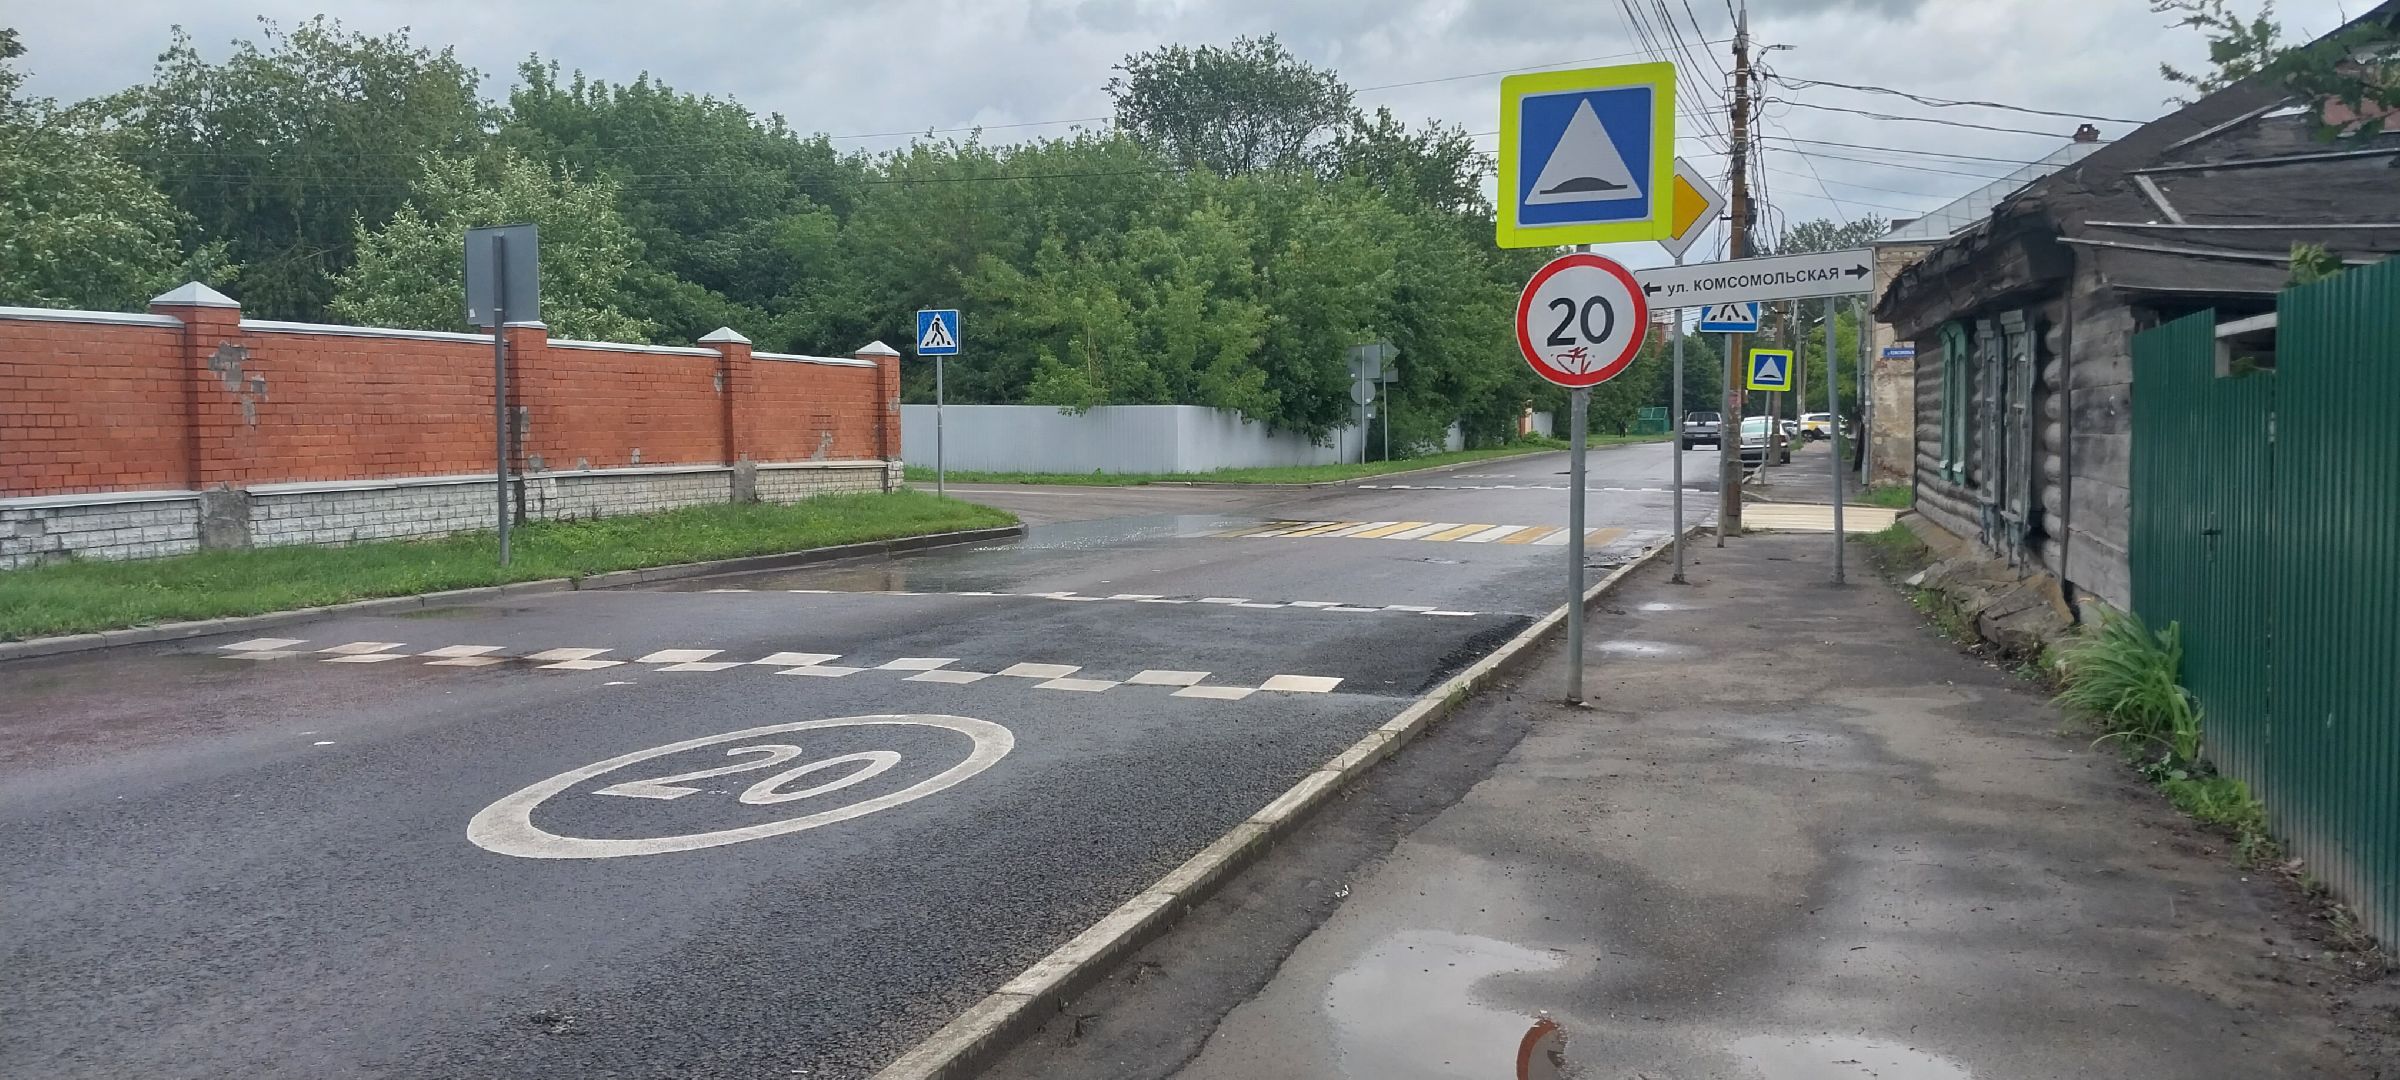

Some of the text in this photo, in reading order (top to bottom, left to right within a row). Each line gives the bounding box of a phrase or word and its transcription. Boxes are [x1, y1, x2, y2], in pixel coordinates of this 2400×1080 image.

[1667, 267, 1839, 297] ул. КОМСОМОЛЬСКАЯ
[1547, 295, 1615, 347] 20
[591, 744, 902, 805] 20
